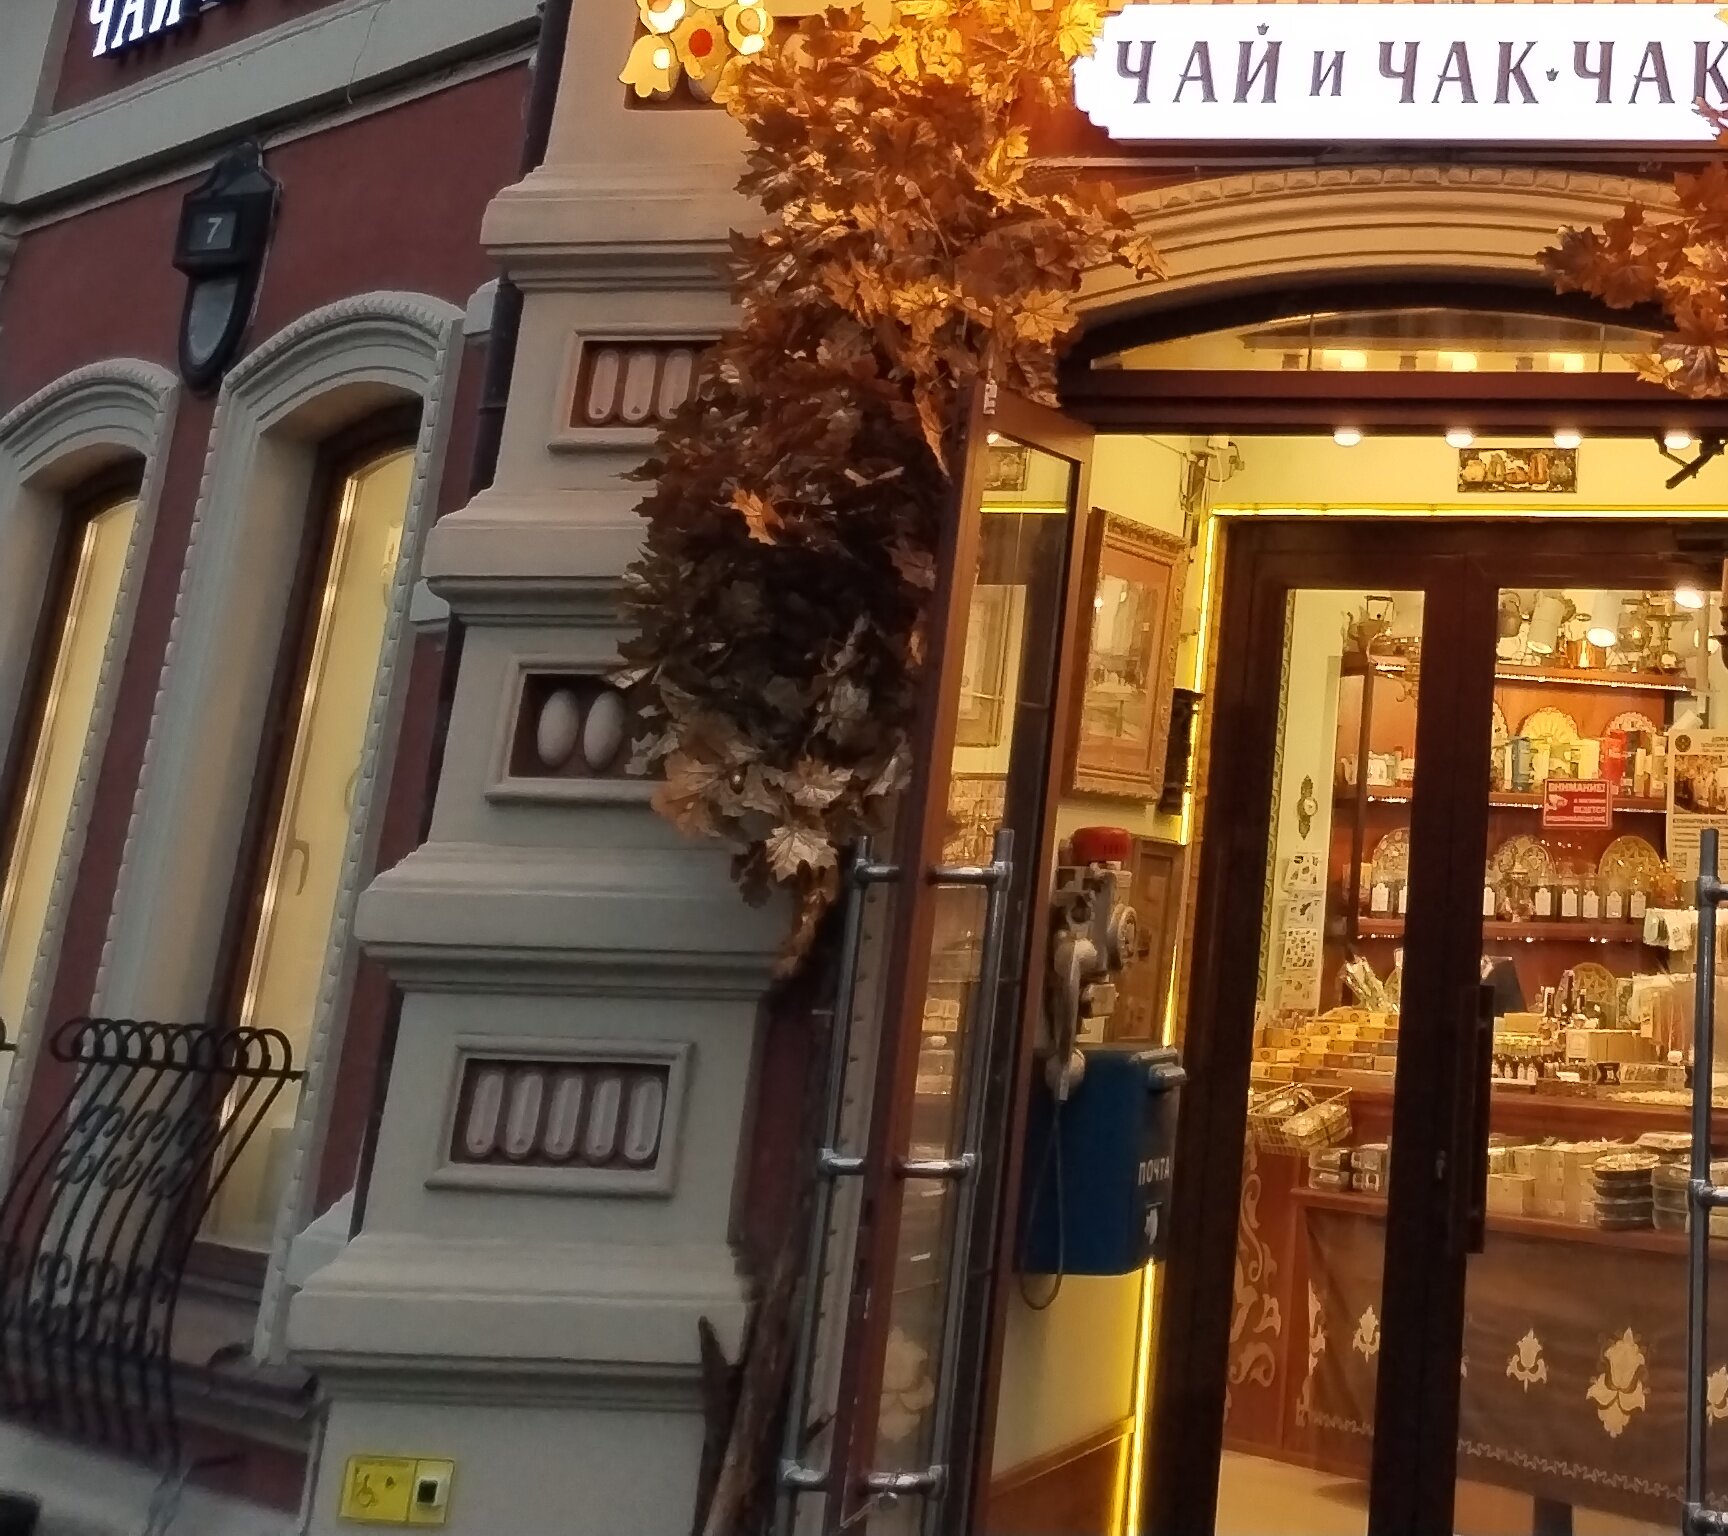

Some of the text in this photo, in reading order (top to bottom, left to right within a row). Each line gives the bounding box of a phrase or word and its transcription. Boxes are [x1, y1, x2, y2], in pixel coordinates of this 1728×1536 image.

[1115, 21, 1281, 106] ЧАЙ
[206, 216, 223, 245] 7
[1137, 1155, 1170, 1186] ПОЧТА
